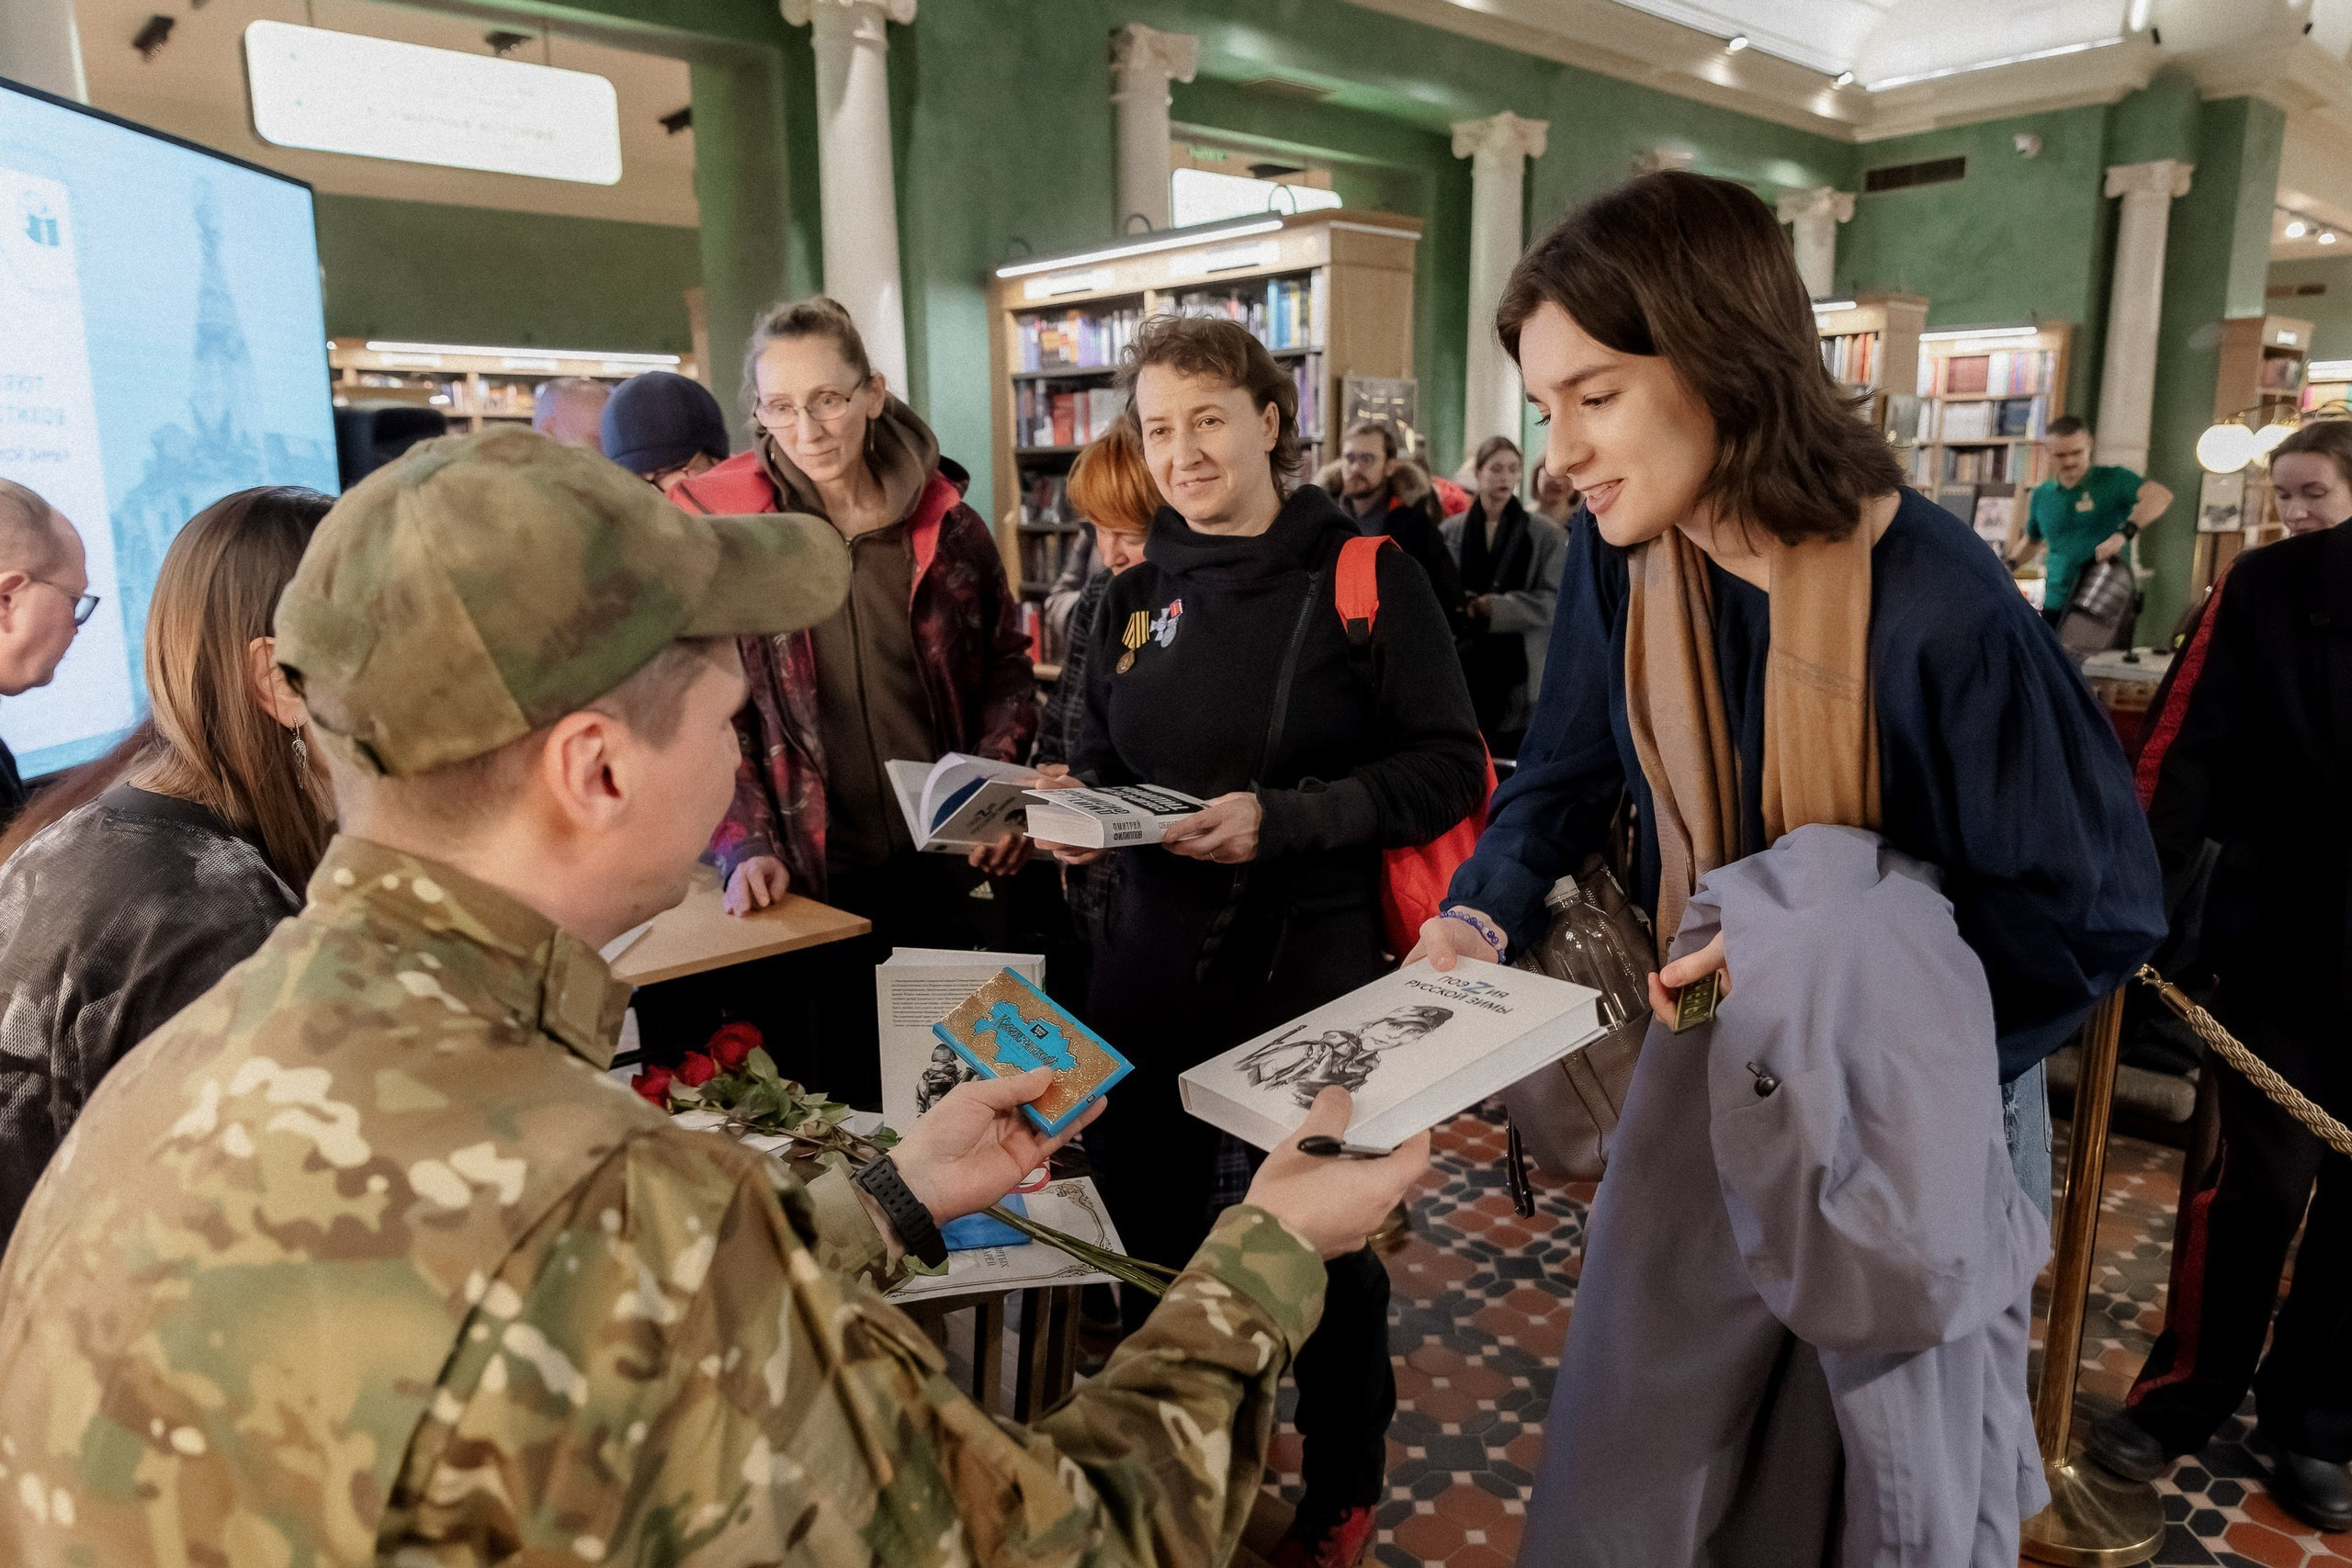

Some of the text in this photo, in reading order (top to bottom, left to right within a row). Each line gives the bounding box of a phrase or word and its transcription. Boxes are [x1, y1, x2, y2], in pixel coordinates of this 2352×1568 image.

[1113, 819, 1142, 831] ДМИТРИЙ
[1113, 830, 1143, 840] ФИЛИППОВ
[1437, 976, 1510, 998] ПОЭZИЯ
[1405, 979, 1513, 1014] РУССКОЙ ЗИМЫ
